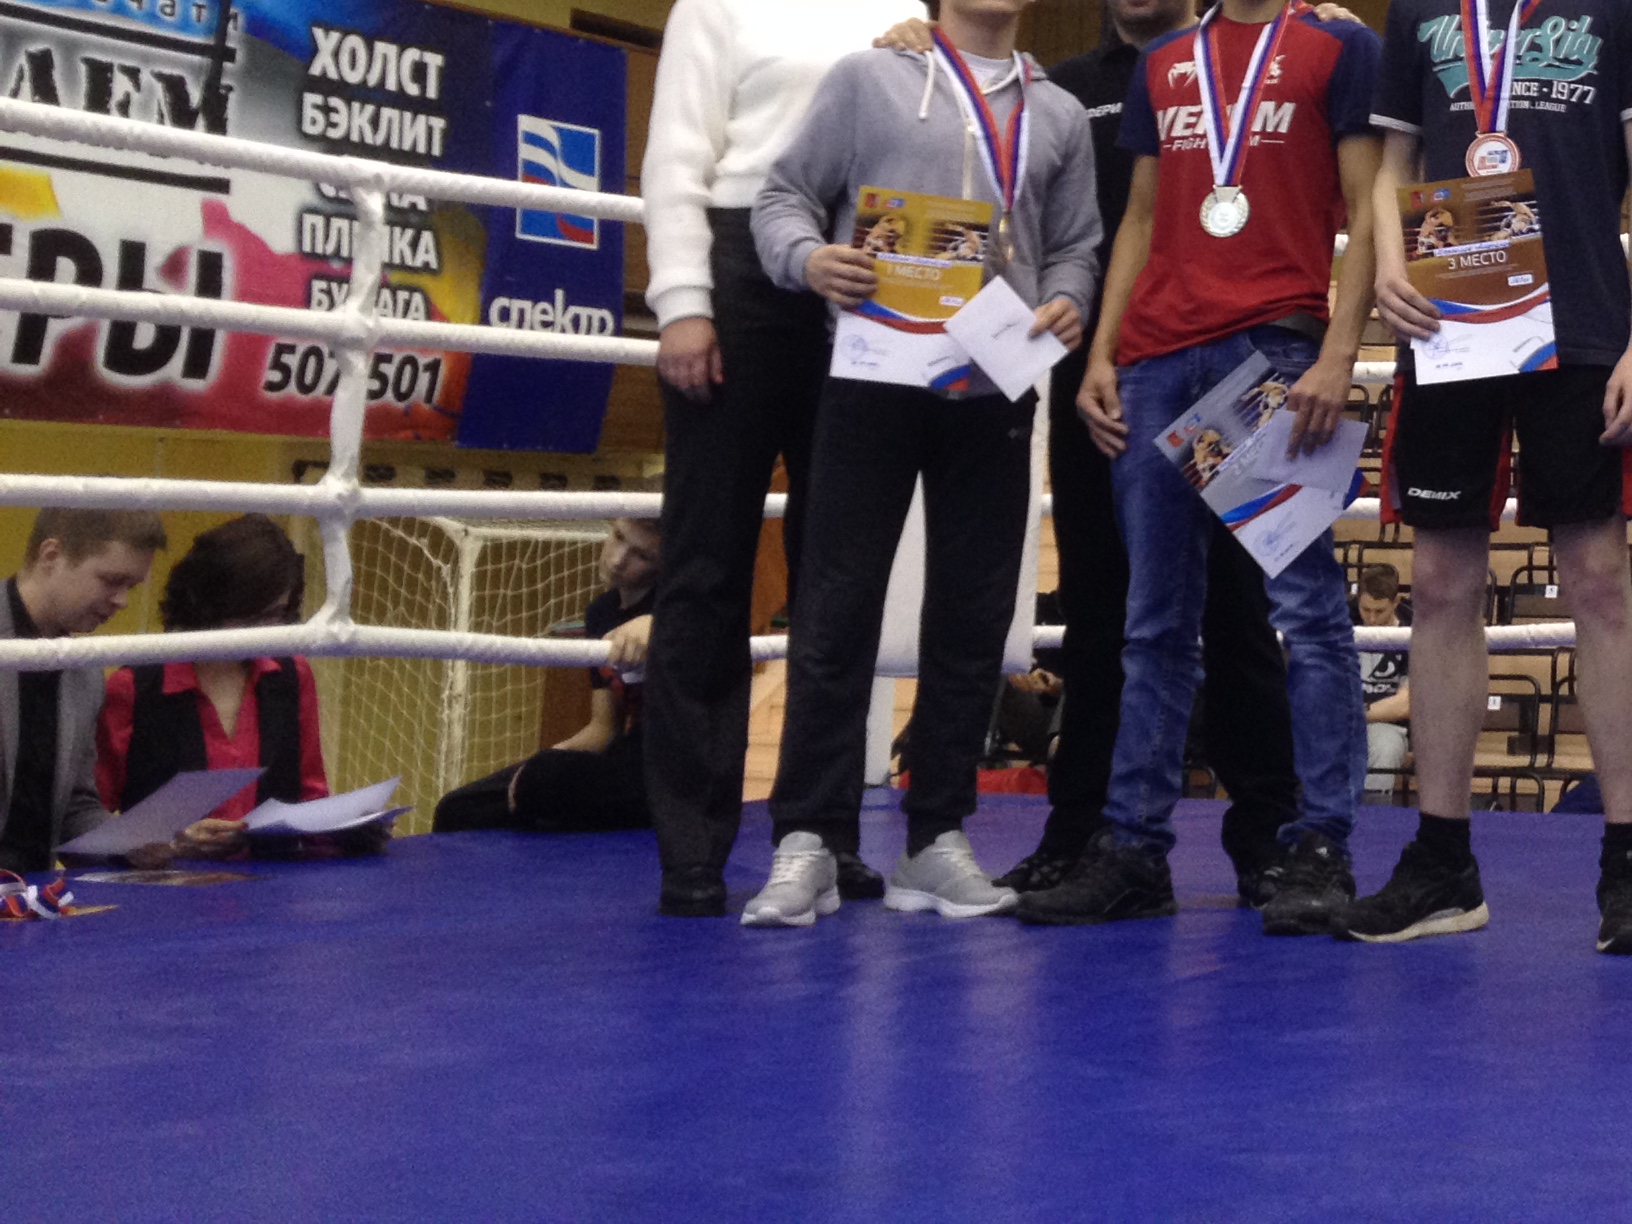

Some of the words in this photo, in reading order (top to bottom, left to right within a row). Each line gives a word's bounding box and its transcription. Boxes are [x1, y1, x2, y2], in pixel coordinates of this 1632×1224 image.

[308, 26, 445, 101] ХОЛСТ
[1550, 79, 1597, 105] 1977
[301, 91, 448, 158] БЭКЛИТ
[301, 212, 440, 271] ПЛКА
[1447, 257, 1456, 270] 3
[1459, 249, 1507, 268] МЕСТО
[0, 222, 224, 381] РЫ
[309, 278, 429, 322] БУАГА
